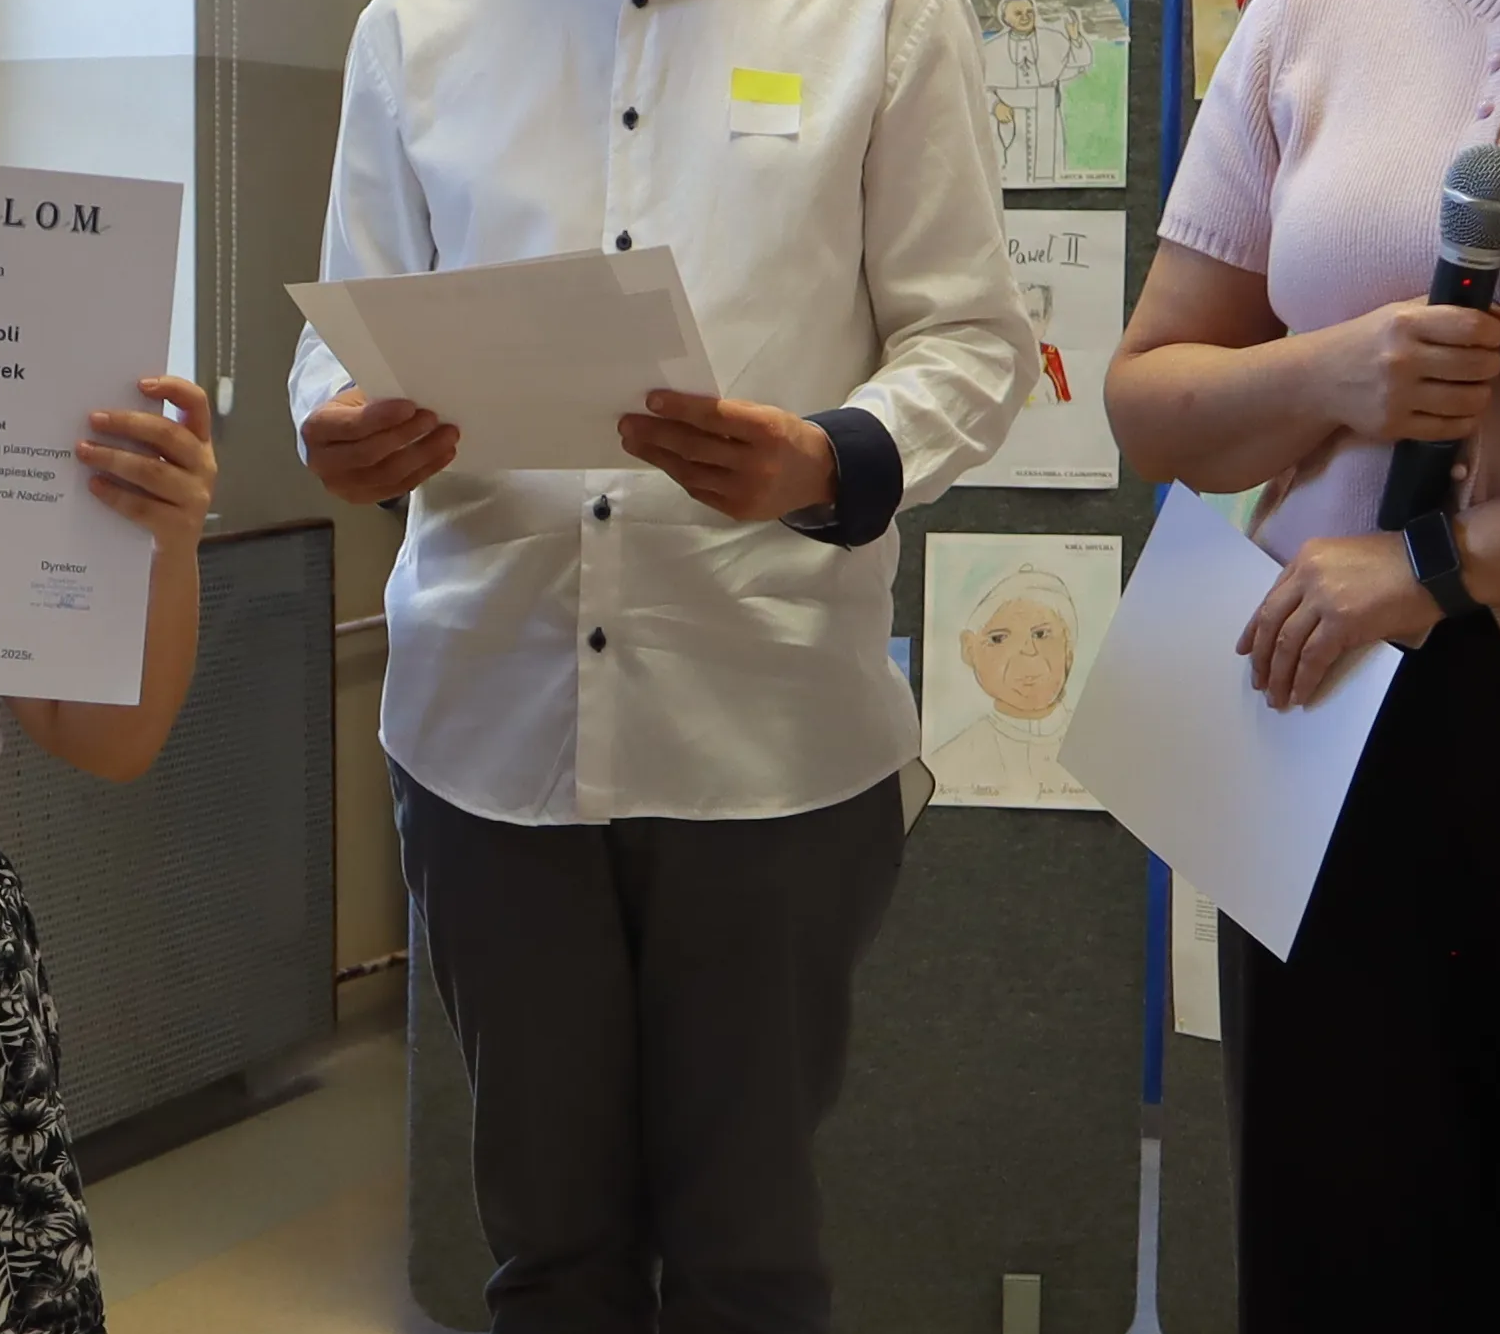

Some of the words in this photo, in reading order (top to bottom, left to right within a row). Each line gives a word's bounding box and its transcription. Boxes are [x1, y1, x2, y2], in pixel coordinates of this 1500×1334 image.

[1060, 232, 1090, 269] II
[3, 444, 72, 459] plastycznym
[41, 559, 88, 575] Dyrektor
